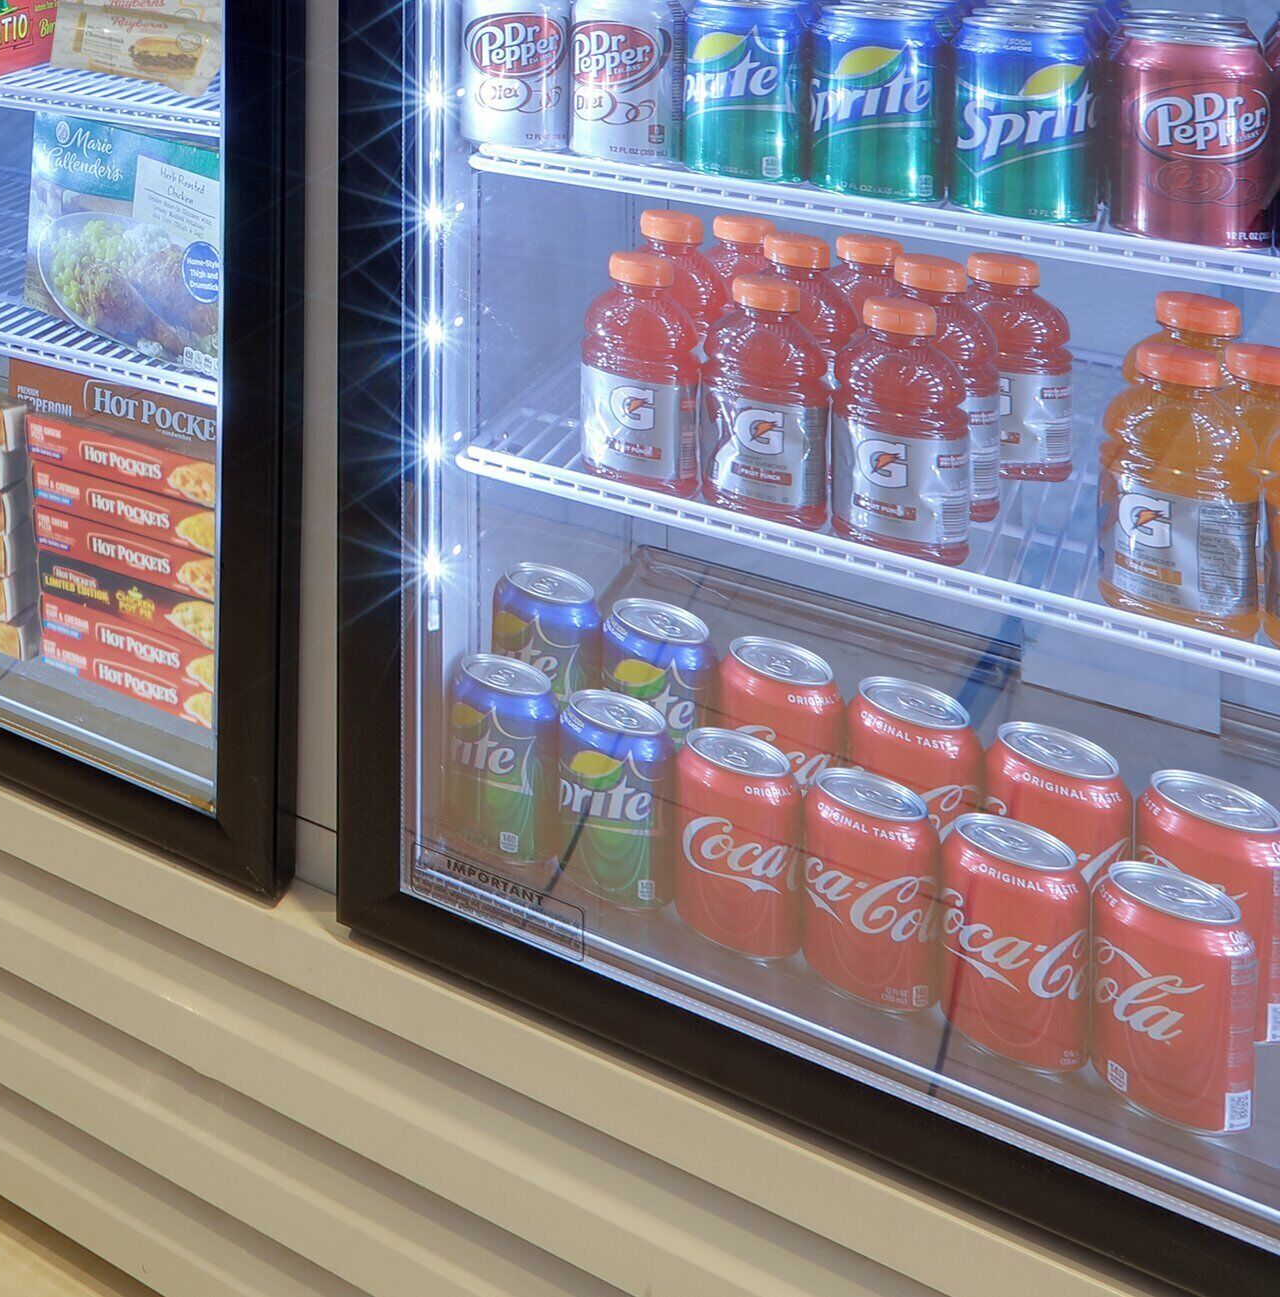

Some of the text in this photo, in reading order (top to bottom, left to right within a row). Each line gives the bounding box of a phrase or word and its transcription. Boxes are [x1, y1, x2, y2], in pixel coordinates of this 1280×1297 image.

[481, 23, 560, 68] Pepper
[503, 22, 540, 43] Dr
[591, 30, 628, 51] Dr
[573, 33, 651, 77] Pepper
[576, 94, 604, 111] Diet
[1193, 92, 1244, 123] Dr
[1142, 97, 1266, 151] Pepper
[70, 127, 114, 158] Marie
[43, 147, 124, 182] Callender's
[159, 166, 205, 195] Herb Roasted
[167, 184, 194, 205] Chicken
[190, 269, 219, 281] Thigh and
[17, 385, 39, 397] PREMIUM
[93, 386, 139, 416] HOT
[610, 387, 654, 431] G
[737, 408, 785, 456] G
[107, 449, 162, 480] POCKETS
[856, 438, 909, 489] G
[116, 497, 171, 530] POCKETS
[1118, 492, 1172, 549] G
[117, 543, 171, 575] POCKETS
[45, 575, 109, 604] LIMITED EDITION
[126, 634, 181, 670] POCKETS
[123, 668, 179, 706] POCKETS
[860, 710, 954, 752] ORIGINAL TASTE
[1022, 771, 1123, 804] ORIGINAL TASTE
[817, 802, 911, 844] ORIGINAL TASTE
[447, 859, 544, 905] IMPORTANT
[979, 863, 1080, 897] ORIGINAL TASTE
